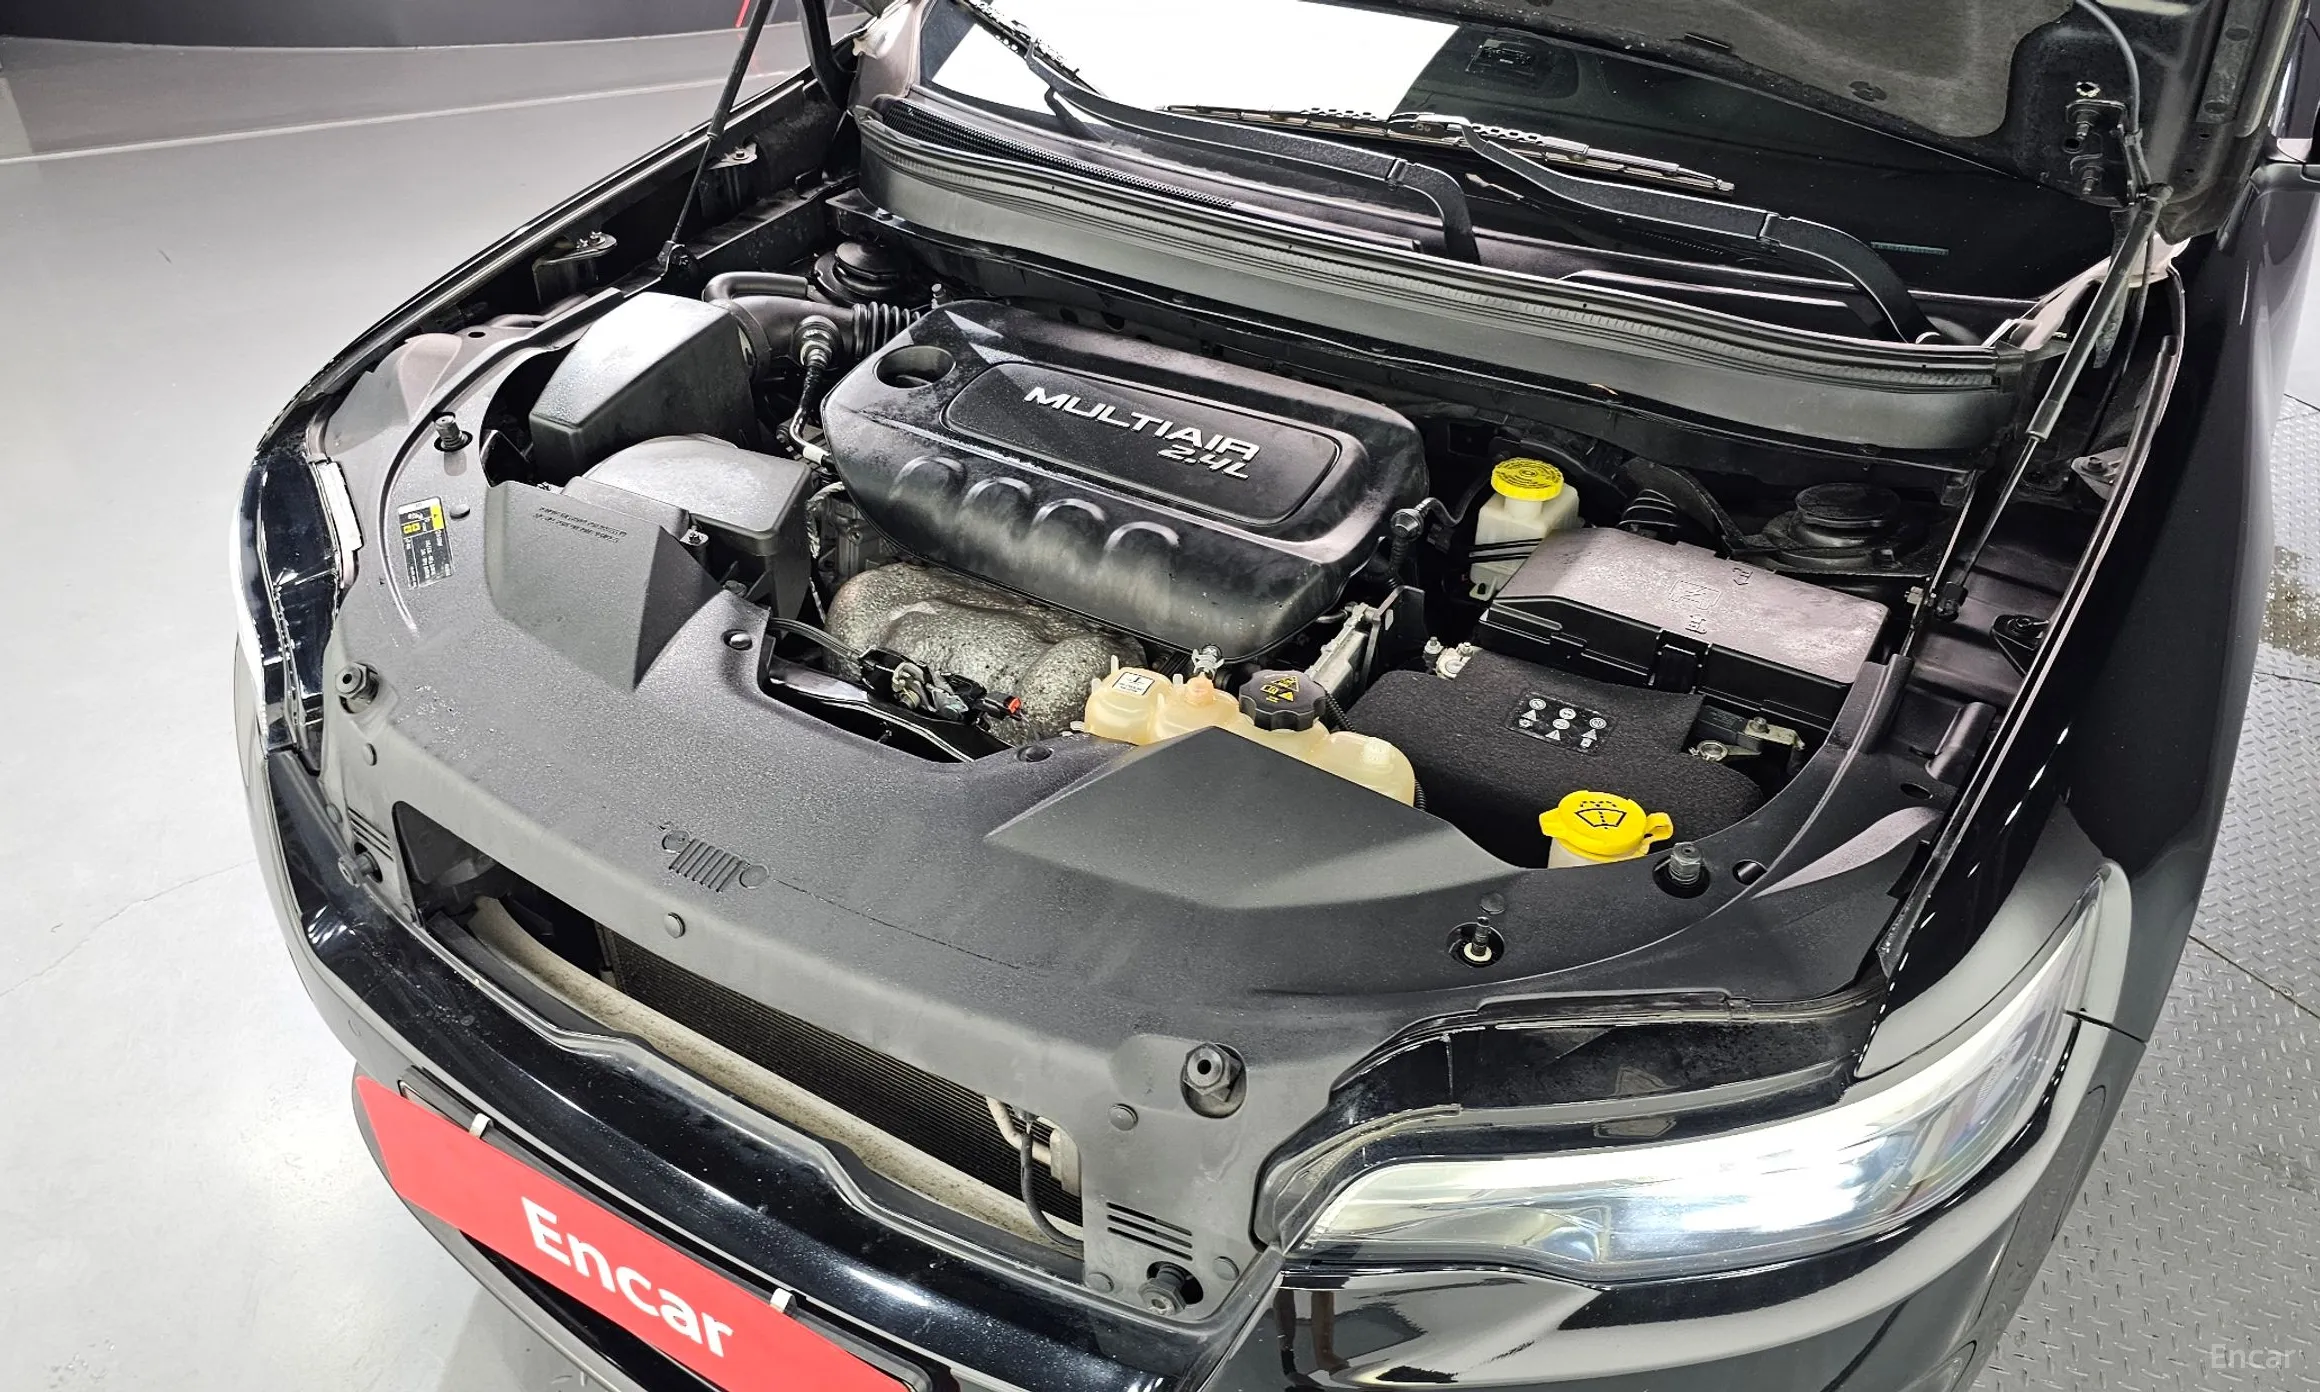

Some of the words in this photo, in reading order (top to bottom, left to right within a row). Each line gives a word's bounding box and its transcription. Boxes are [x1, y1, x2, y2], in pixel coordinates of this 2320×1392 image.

[1023, 386, 1260, 462] MULTIAIR
[1157, 444, 1249, 480] 2.4L
[521, 1196, 734, 1358] Encar
